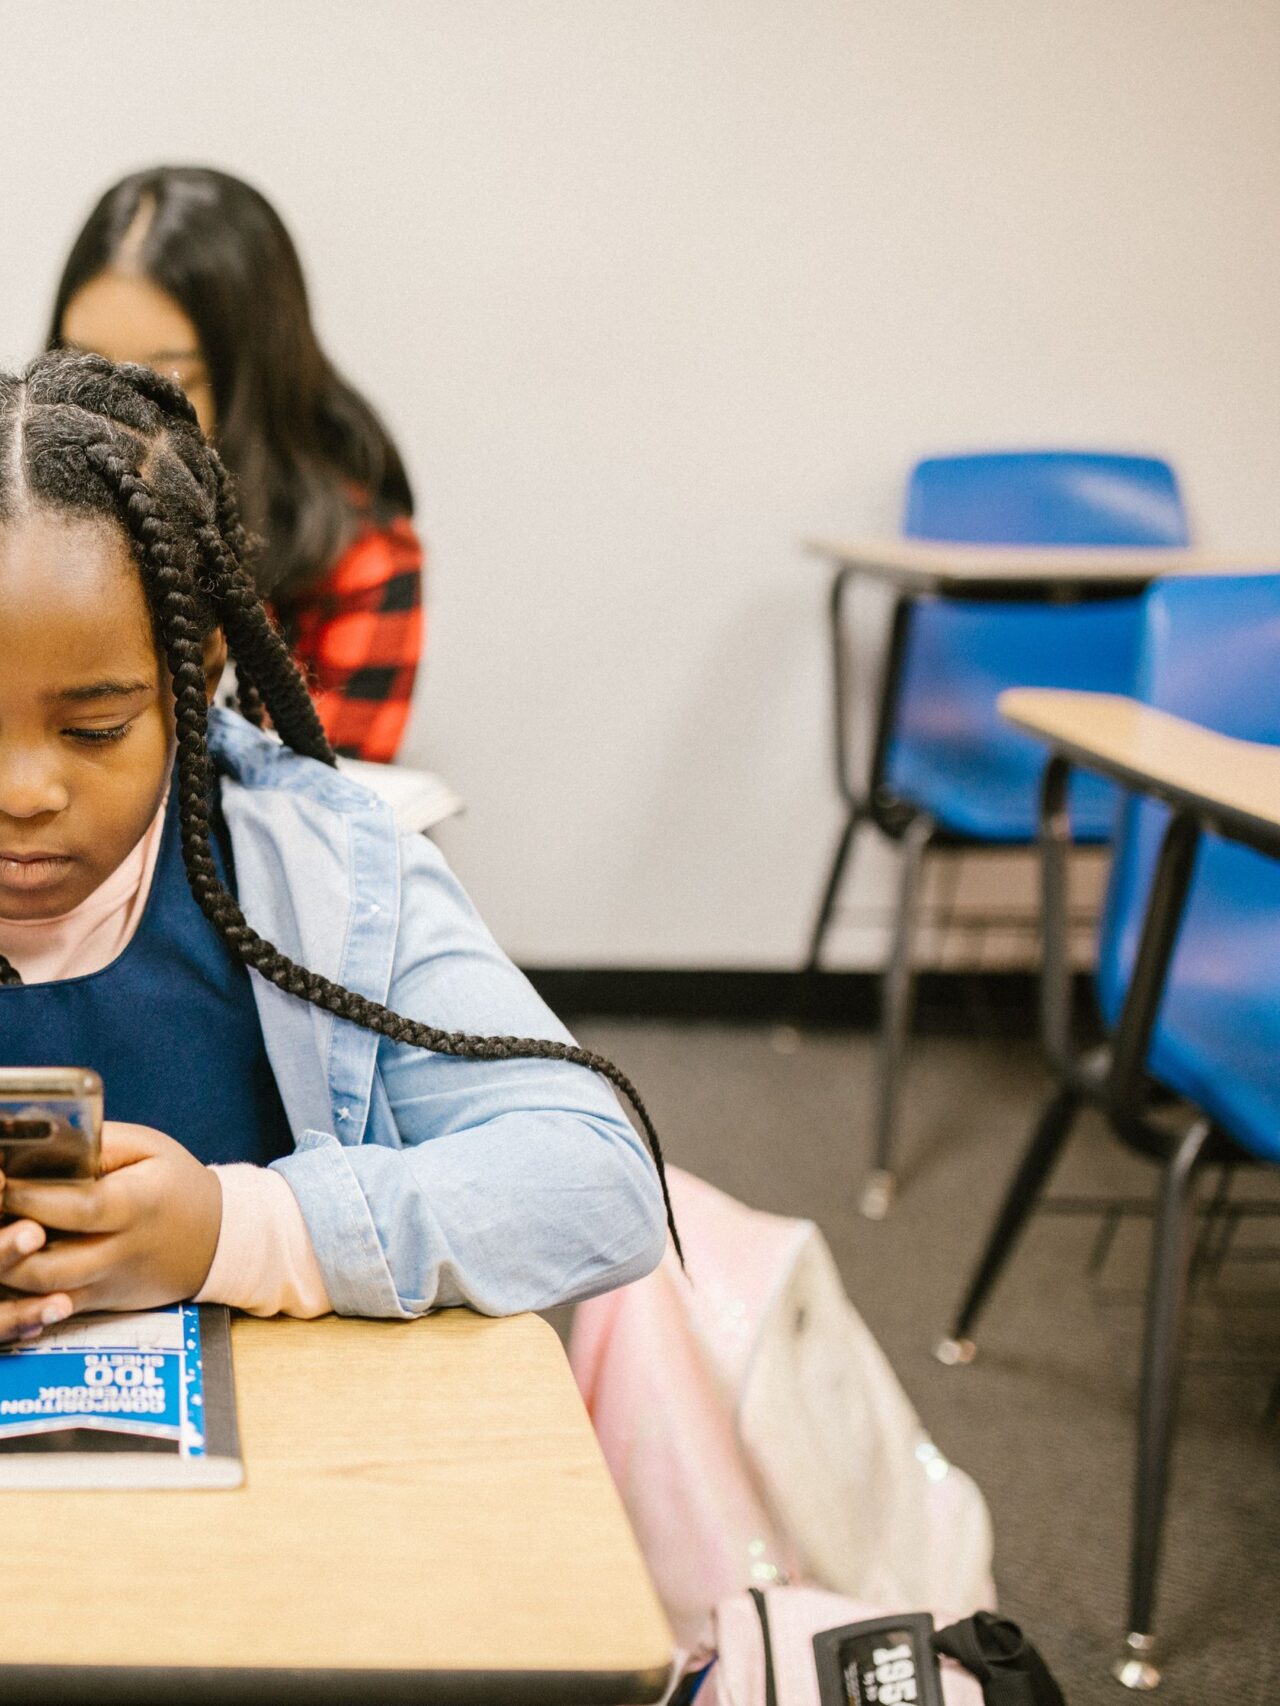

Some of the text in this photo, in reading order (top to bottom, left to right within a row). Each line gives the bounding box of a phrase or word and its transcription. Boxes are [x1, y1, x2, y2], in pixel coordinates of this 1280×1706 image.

[84, 1354, 165, 1366] SHEETS
[84, 1366, 164, 1387] 100
[39, 1386, 165, 1400] NOTEBOOK
[0, 1399, 166, 1414] COMPOSITION
[873, 1644, 918, 1706] 195
